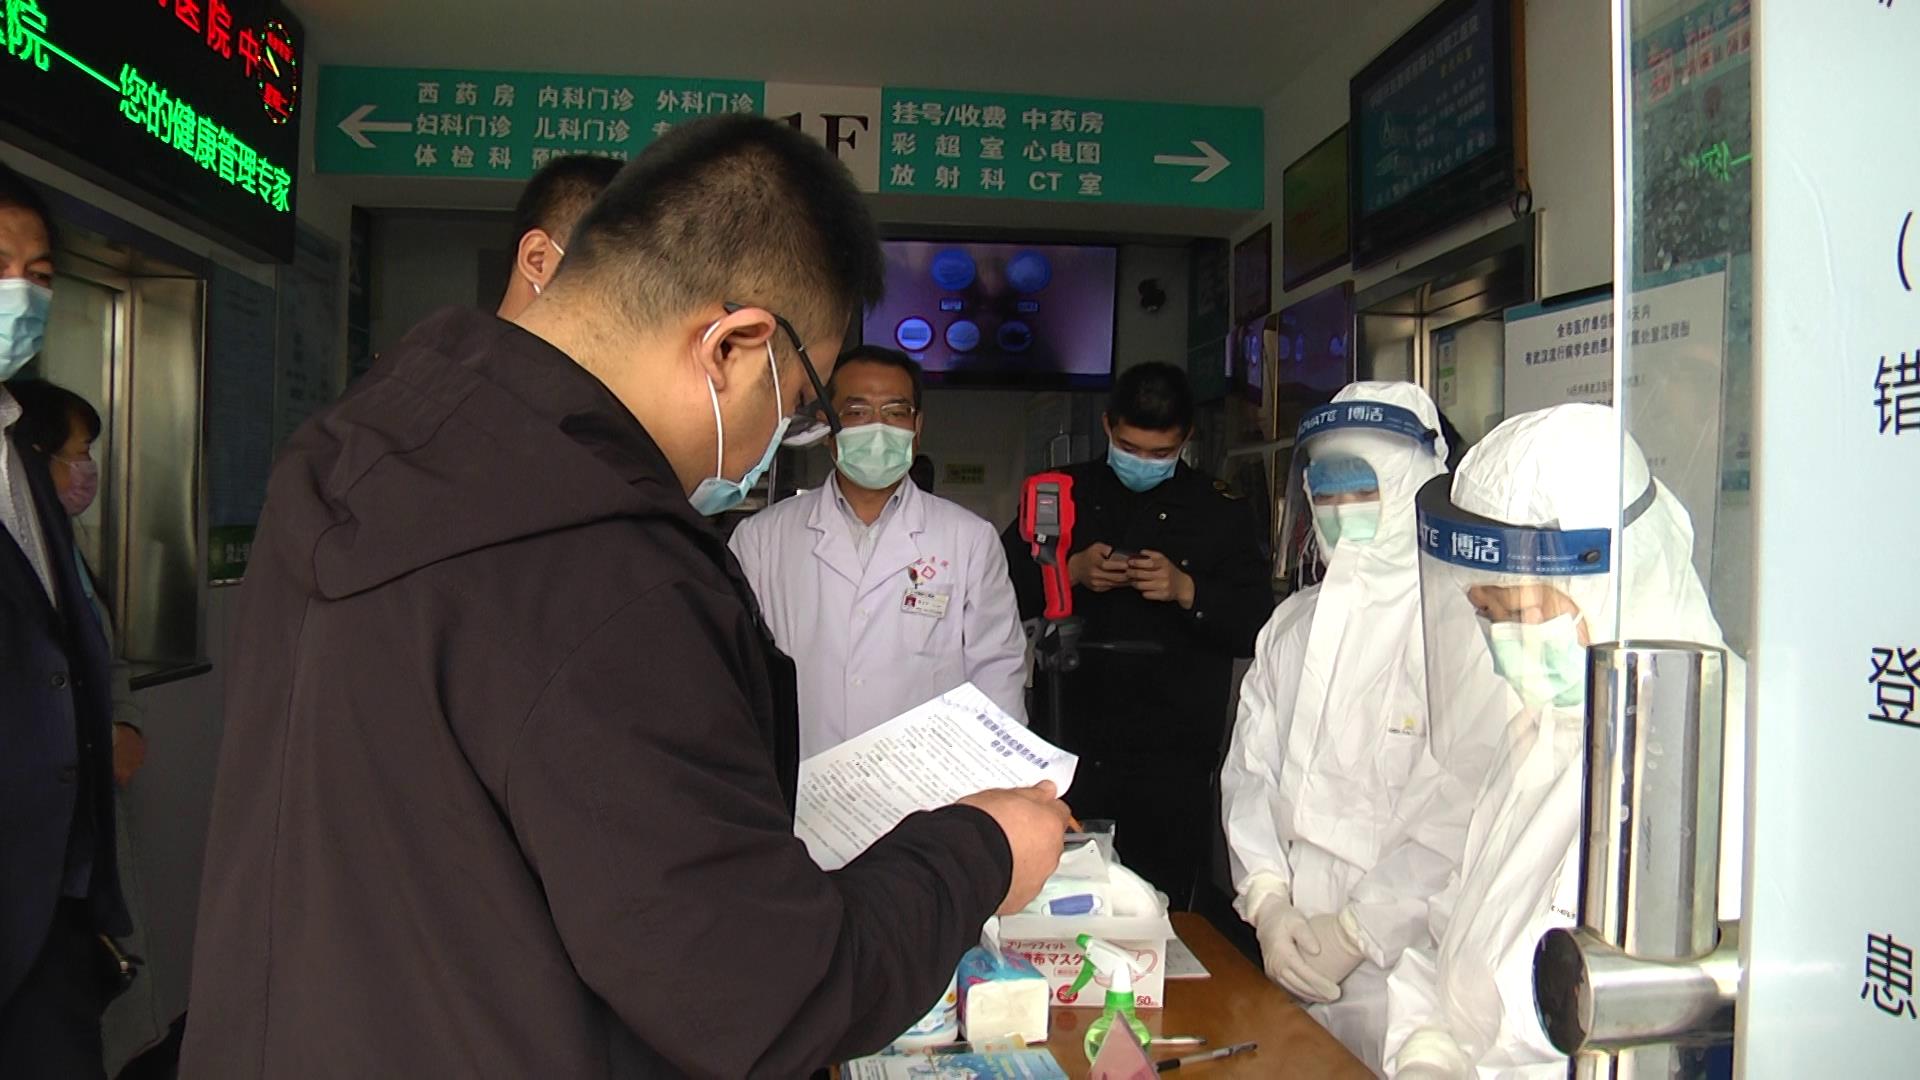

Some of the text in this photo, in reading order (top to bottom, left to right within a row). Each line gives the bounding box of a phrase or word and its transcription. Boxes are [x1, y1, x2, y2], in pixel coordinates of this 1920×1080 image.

[538, 87, 635, 113] 内科门诊
[656, 91, 754, 114] 外科门诊
[416, 113, 512, 139] 妇科门诊
[534, 119, 631, 143] 儿科门诊
[892, 101, 1104, 134] 挂号/收费 中药房
[1022, 138, 1101, 164] 心电图
[1452, 531, 1500, 564] 博活
